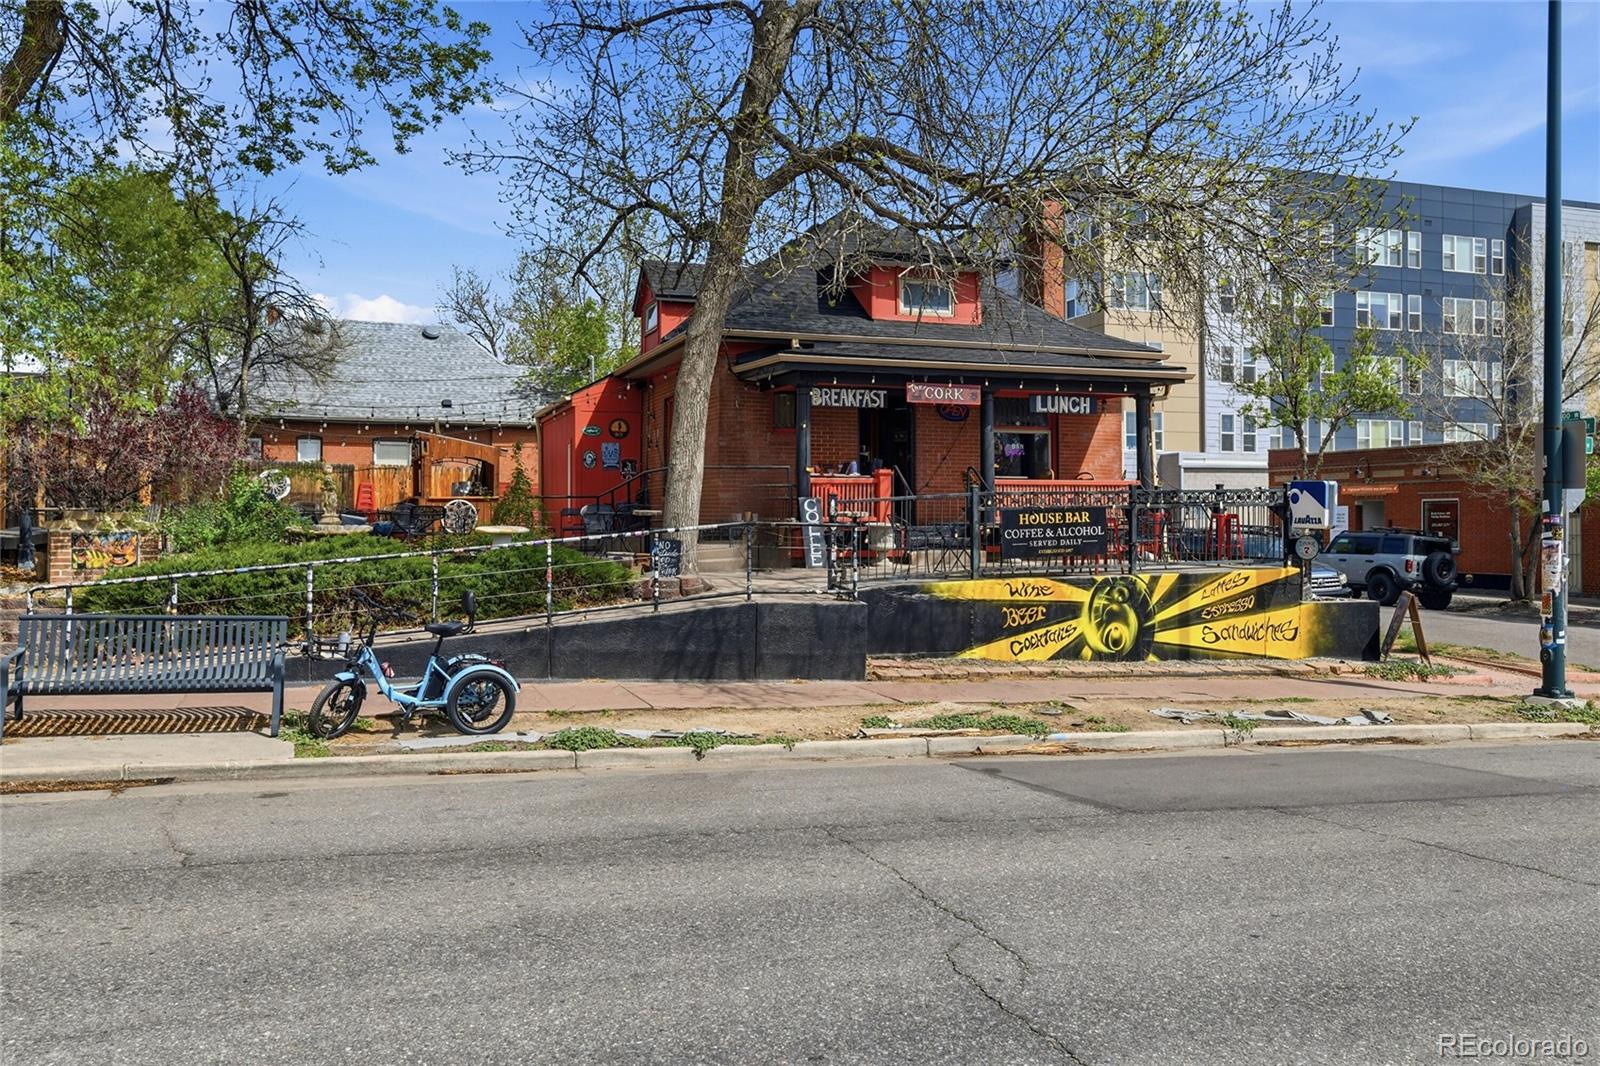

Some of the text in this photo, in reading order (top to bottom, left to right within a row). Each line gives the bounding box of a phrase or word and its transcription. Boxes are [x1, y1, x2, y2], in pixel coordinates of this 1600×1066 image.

[811, 387, 887, 408] BREAKFAST
[924, 387, 965, 400] CORK
[1036, 395, 1091, 414] LUNCH
[1019, 511, 1090, 525] HOUSE BAR
[1294, 515, 1322, 524] LAVAZZA
[1004, 526, 1105, 539] COFFEE & ALCOHOL
[1004, 581, 1055, 598] Wine
[1001, 605, 1047, 629] Beer
[1201, 617, 1299, 644] Sandwiches
